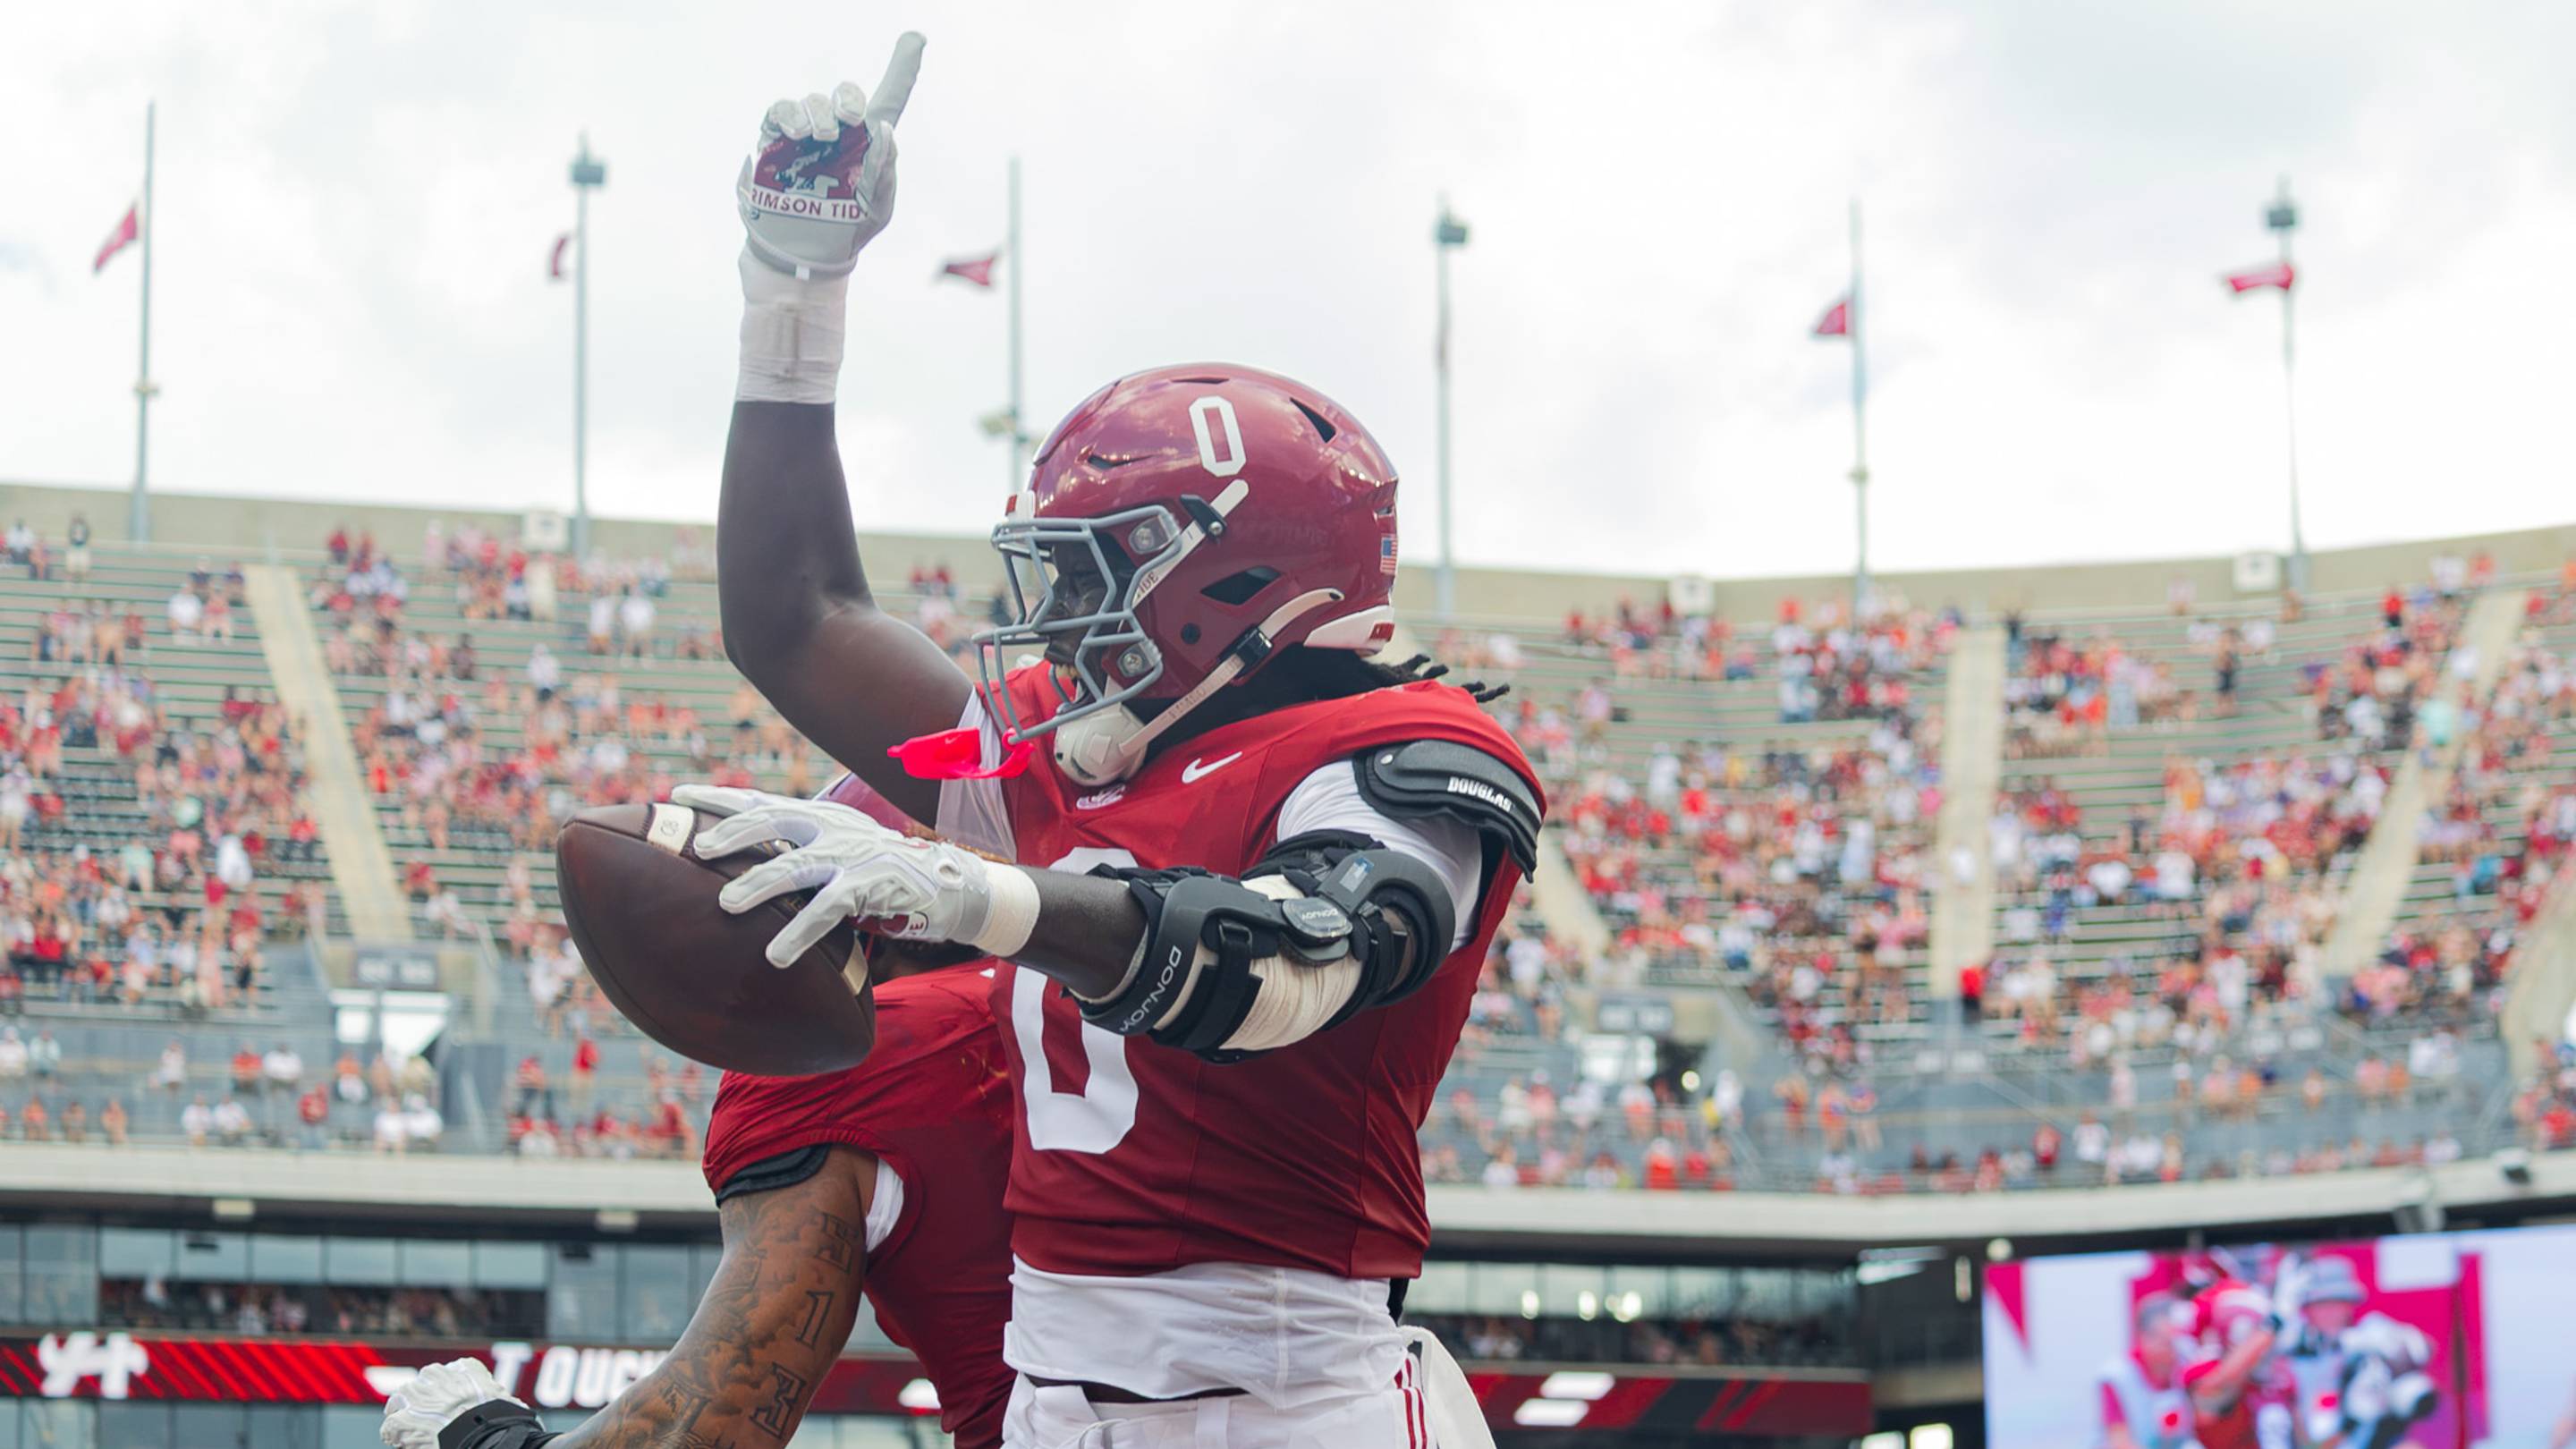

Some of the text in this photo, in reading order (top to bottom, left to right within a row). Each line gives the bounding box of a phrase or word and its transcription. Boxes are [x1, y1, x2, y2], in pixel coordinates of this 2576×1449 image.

[751, 189, 867, 219] RIMSON TID
[1188, 395, 1247, 477] 0
[1136, 572, 1159, 600] IDE
[1447, 776, 1512, 812] DOUGLAS
[1119, 945, 1182, 1032] DONJOY
